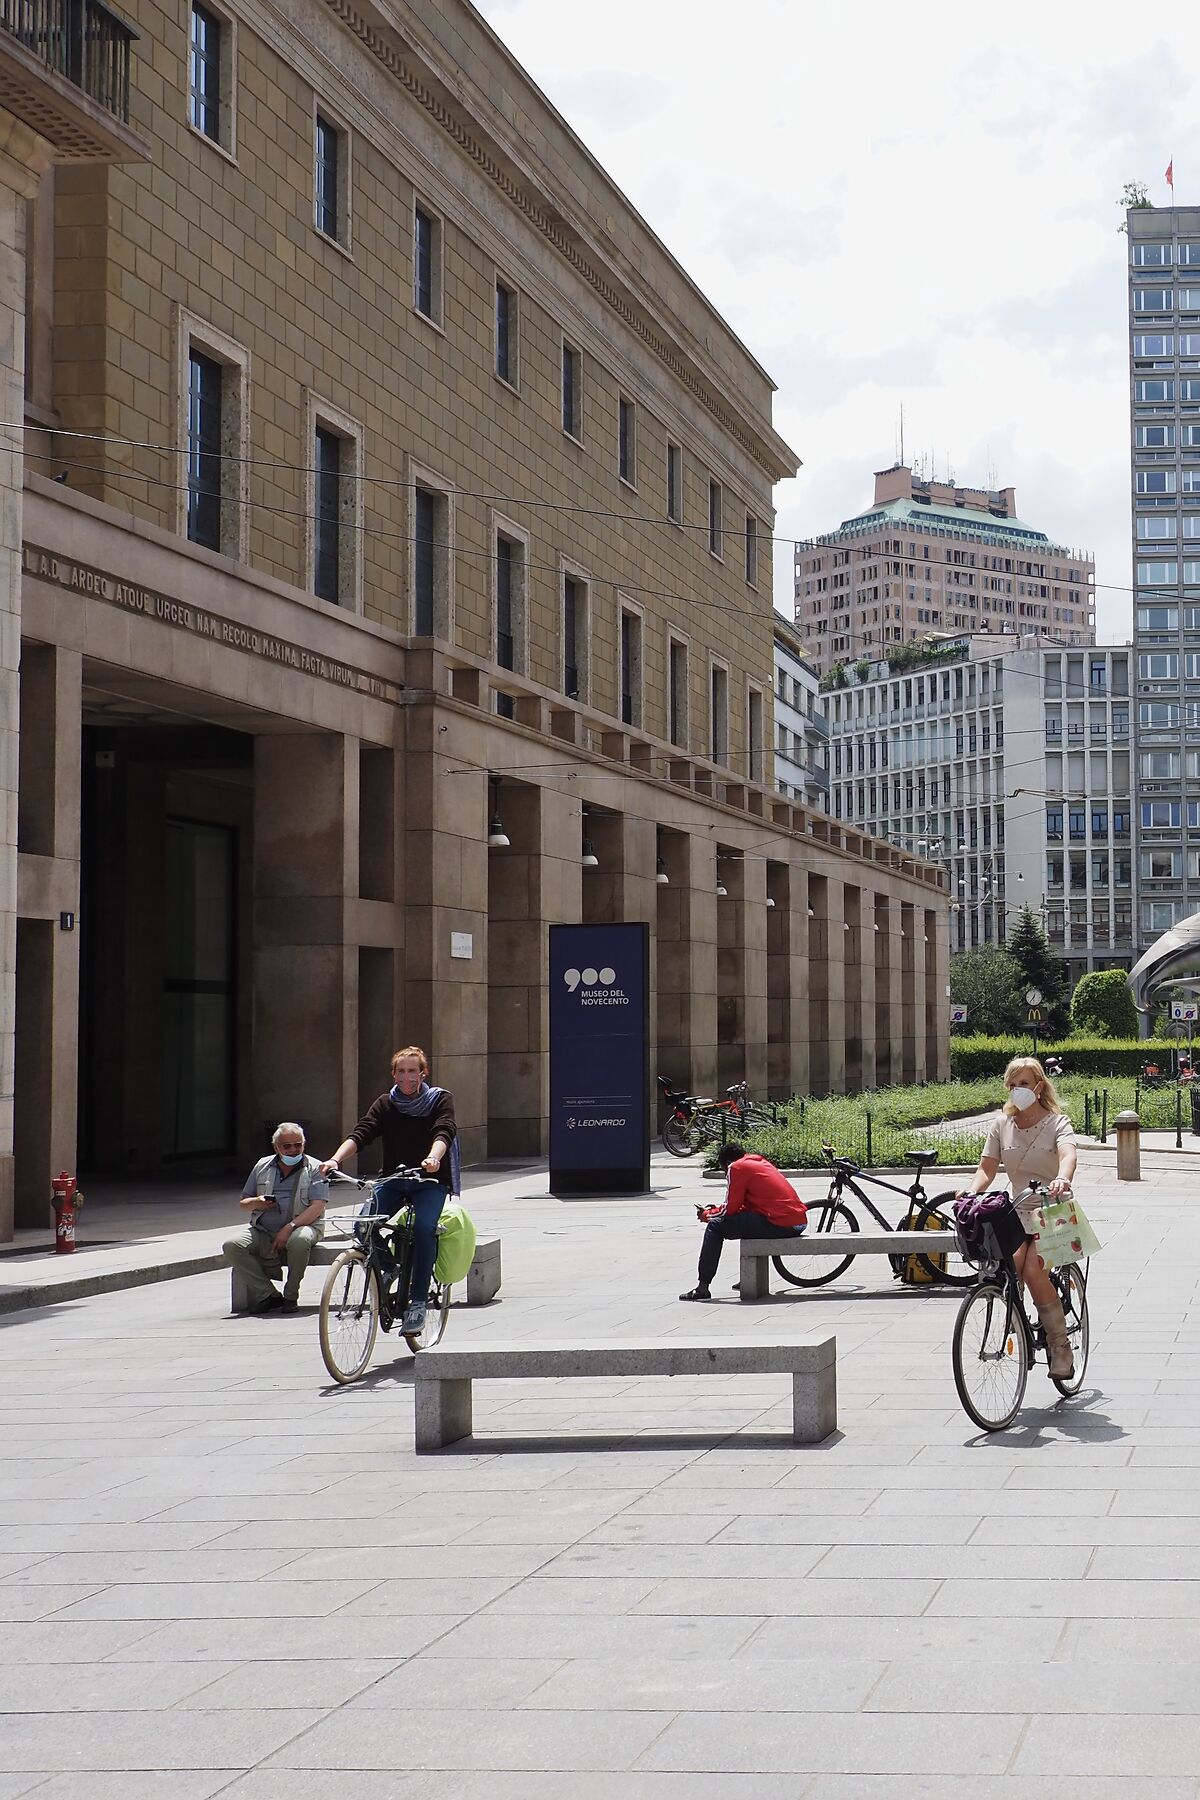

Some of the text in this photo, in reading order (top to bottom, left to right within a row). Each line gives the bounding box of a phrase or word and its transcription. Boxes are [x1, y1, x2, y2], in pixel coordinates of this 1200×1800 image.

[196, 613, 217, 636] NAM
[222, 623, 258, 652] RECOLO
[262, 637, 297, 666] MAXIMA
[66, 914, 71, 928] 1
[581, 989, 625, 998] MUSEO DEL
[581, 998, 630, 1006] NOVECENTO
[577, 1118, 626, 1127] LEONARDO
